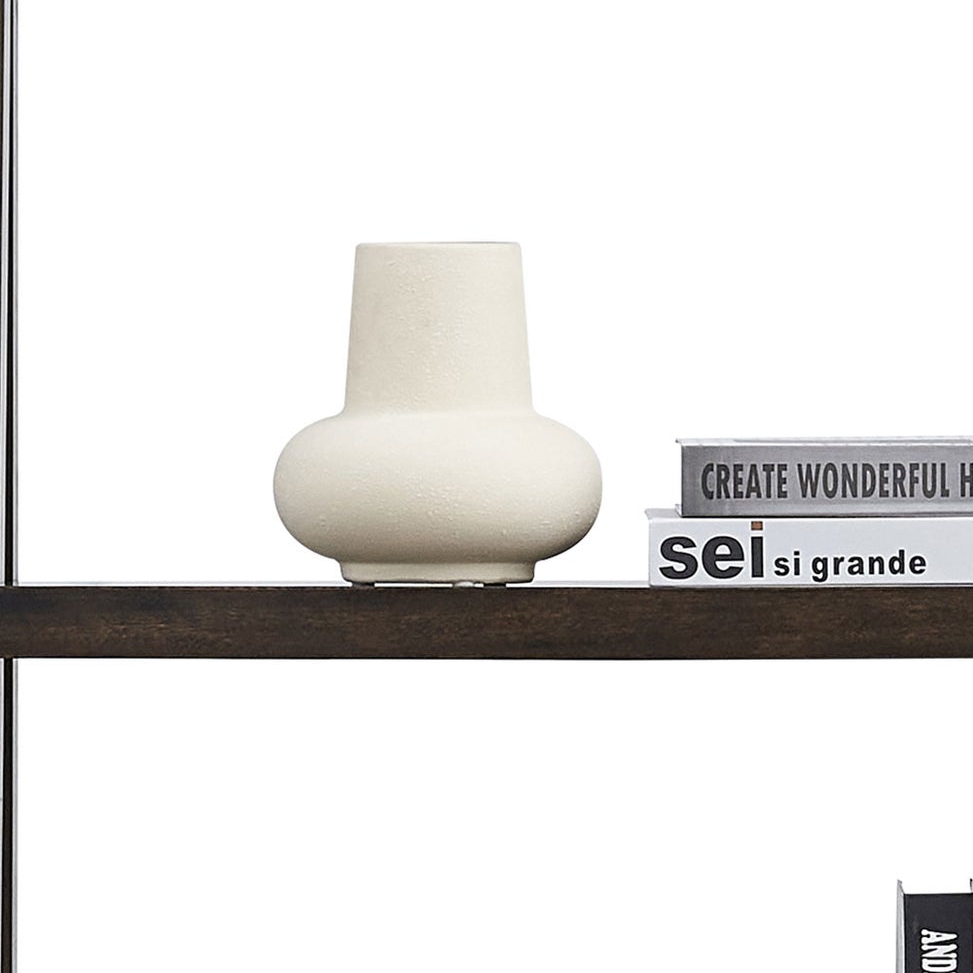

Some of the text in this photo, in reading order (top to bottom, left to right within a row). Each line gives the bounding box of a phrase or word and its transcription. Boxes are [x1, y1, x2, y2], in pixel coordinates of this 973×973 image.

[701, 463, 788, 500] CREATE
[797, 462, 950, 499] WONDERFUL
[659, 521, 928, 583] sei si grande
